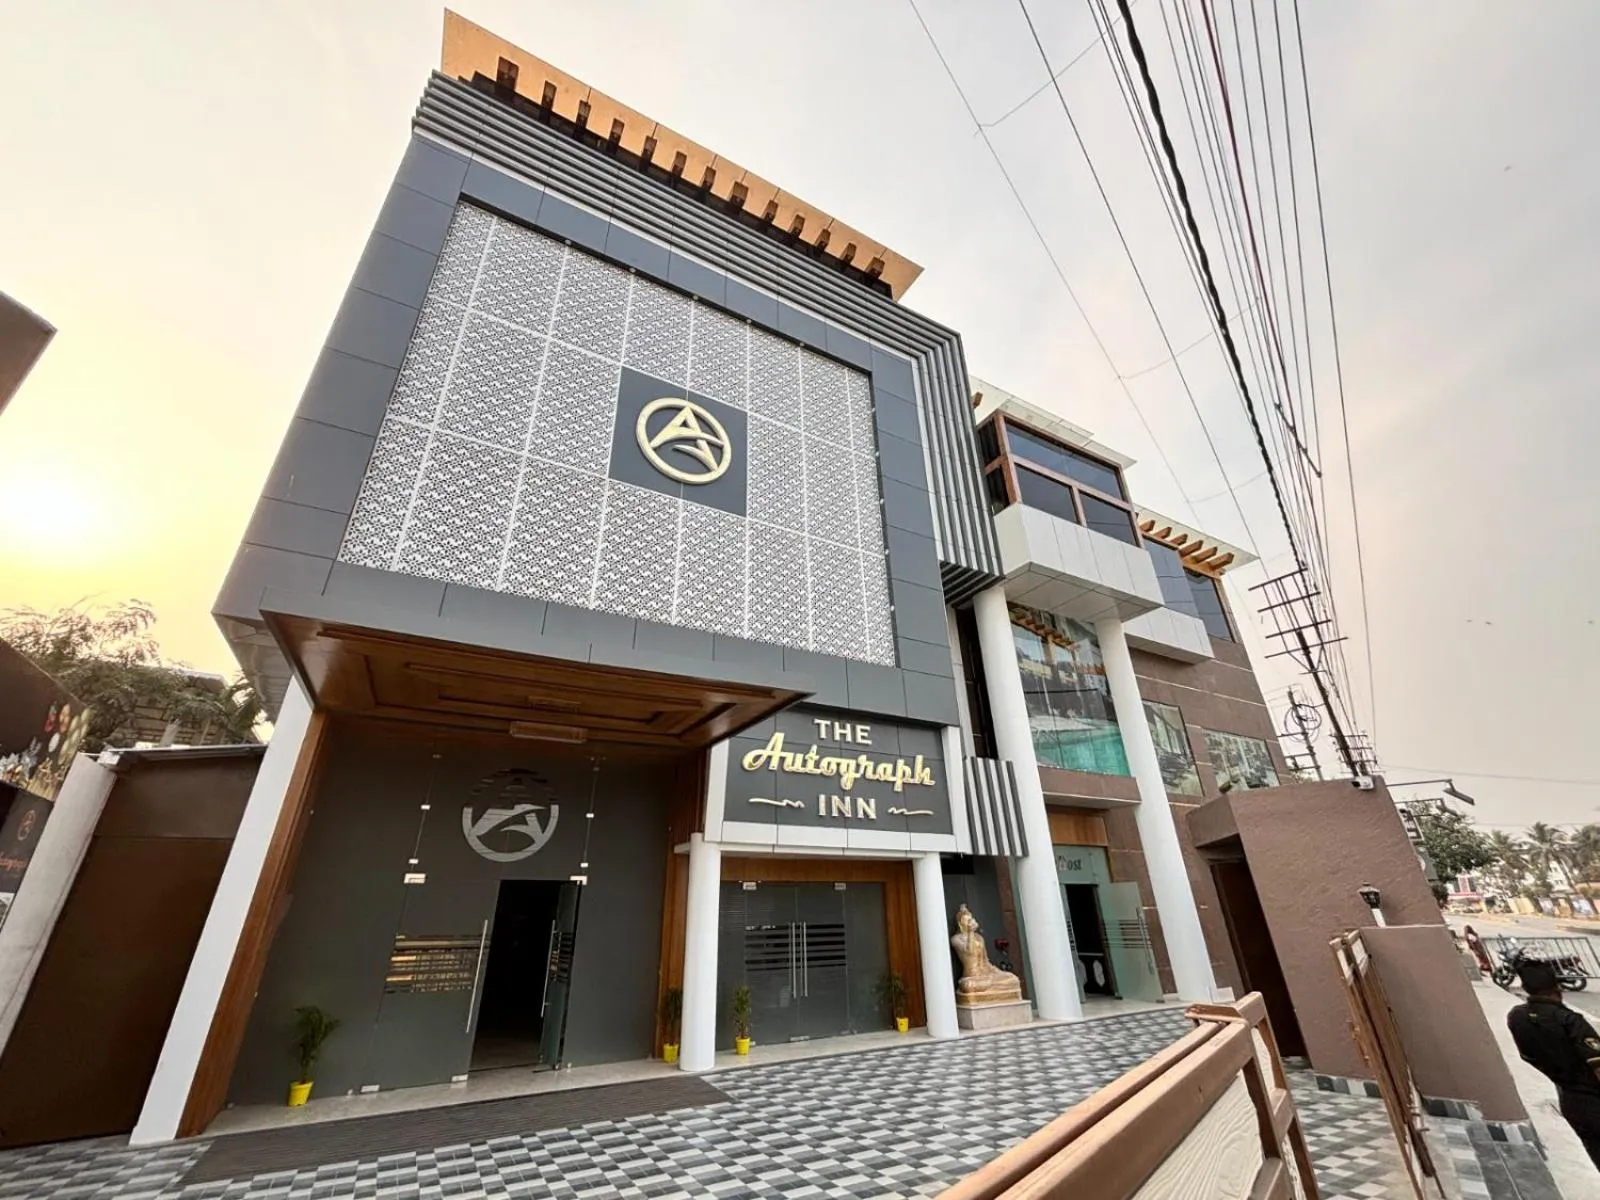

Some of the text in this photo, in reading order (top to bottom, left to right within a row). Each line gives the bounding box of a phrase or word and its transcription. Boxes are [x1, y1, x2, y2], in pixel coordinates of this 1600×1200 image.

[814, 718, 873, 745] THE
[742, 732, 936, 792] Autograph
[818, 794, 877, 820] INN
